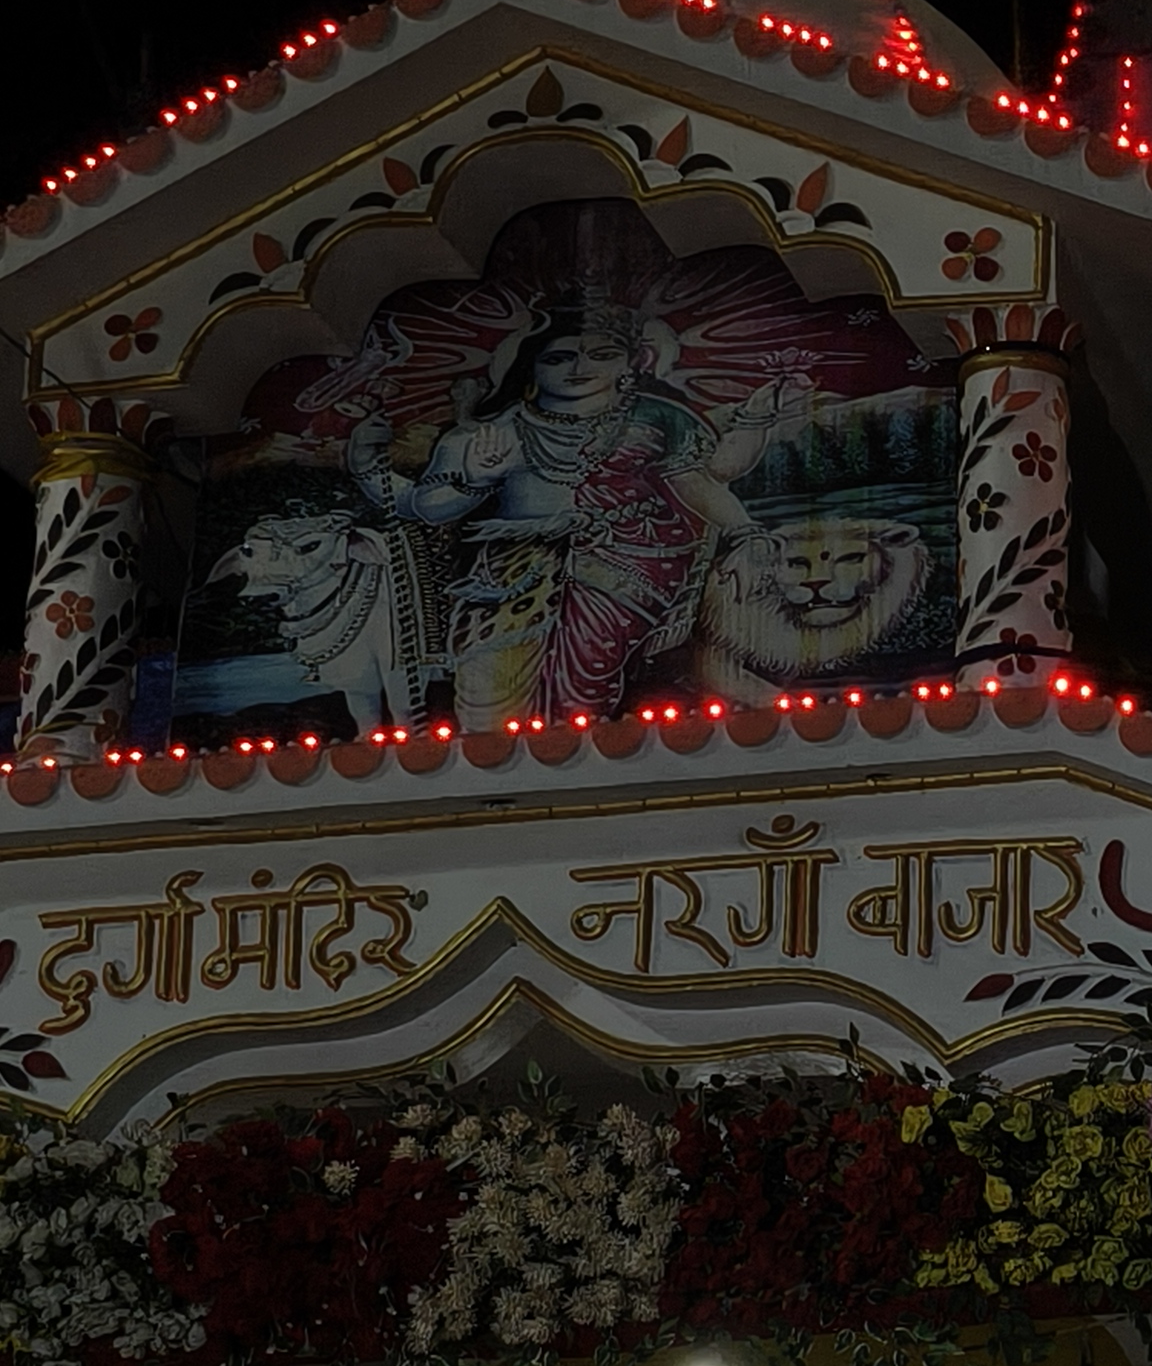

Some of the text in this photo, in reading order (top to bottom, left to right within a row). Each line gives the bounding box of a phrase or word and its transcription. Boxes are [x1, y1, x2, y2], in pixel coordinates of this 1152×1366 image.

[38, 870, 206, 1035] दुर्गा
[201, 863, 418, 991] मंदिर
[847, 836, 1086, 958] बाजार
